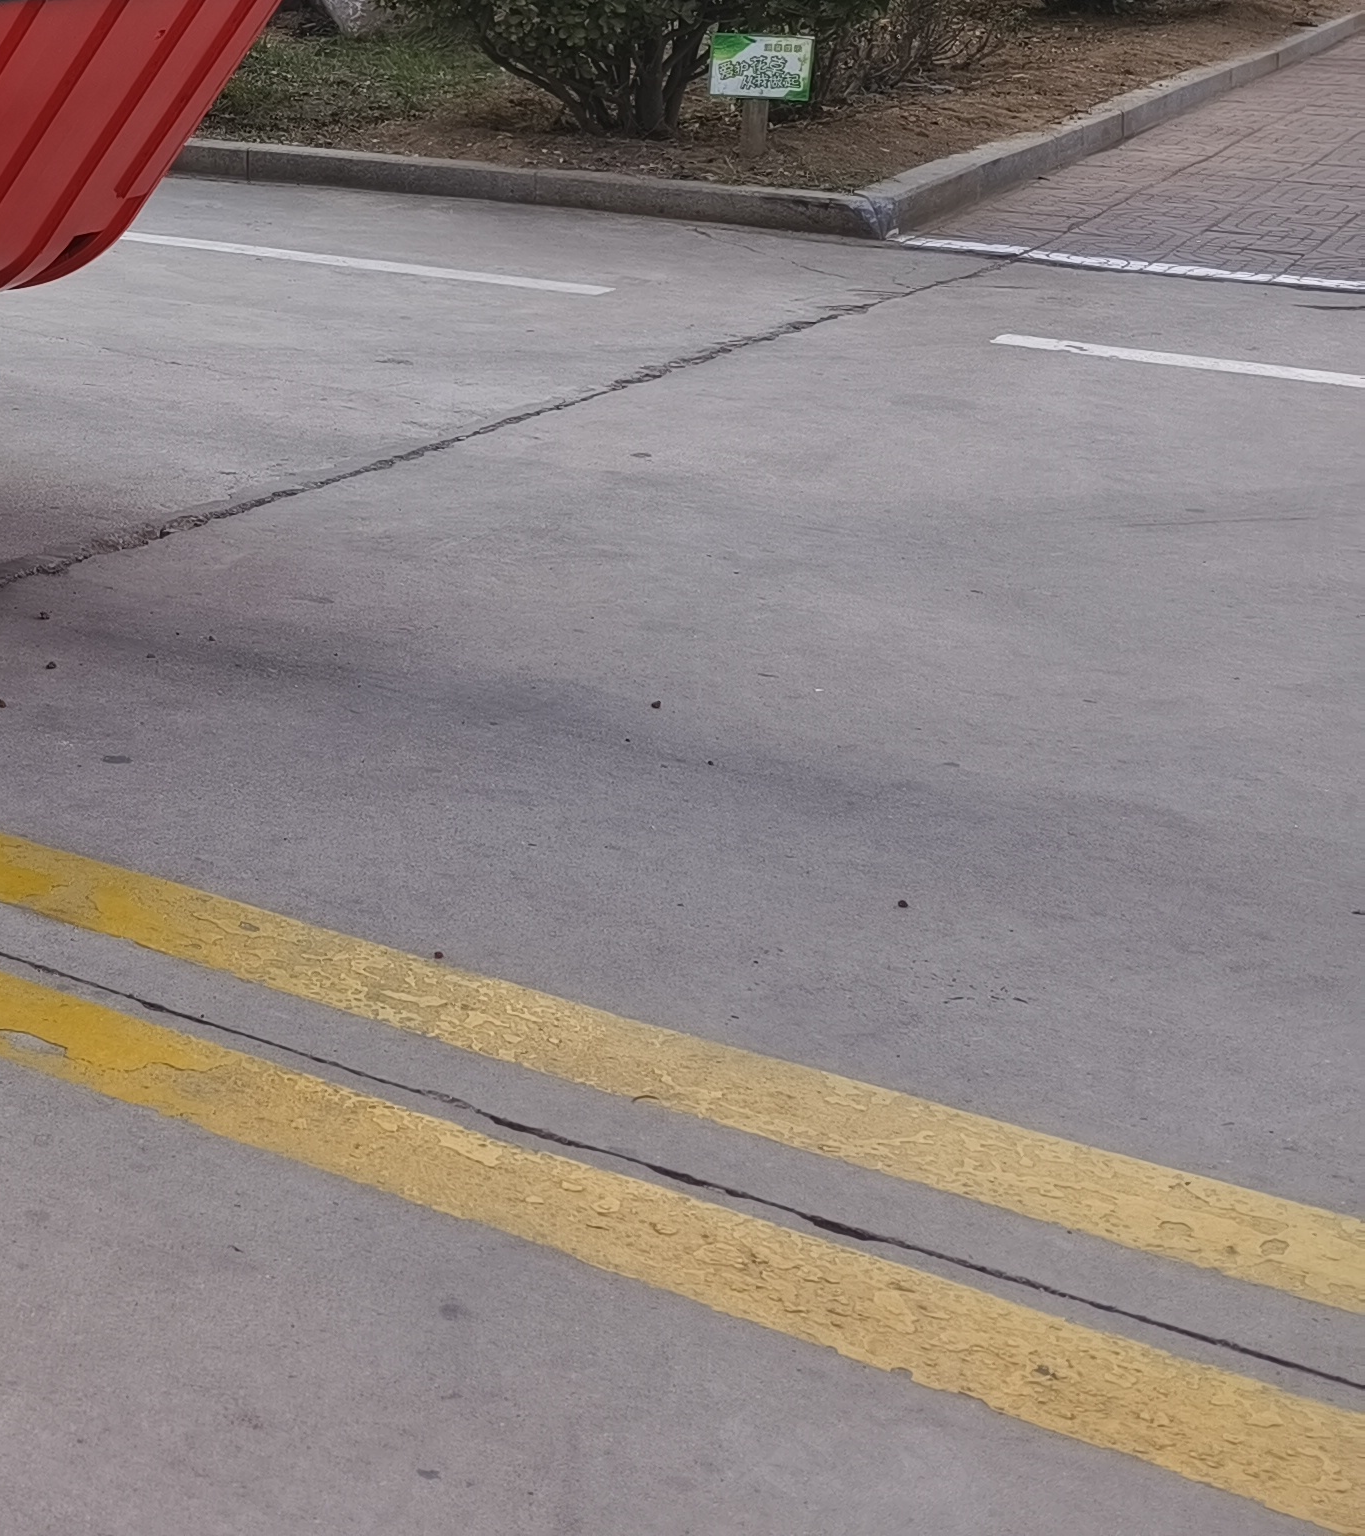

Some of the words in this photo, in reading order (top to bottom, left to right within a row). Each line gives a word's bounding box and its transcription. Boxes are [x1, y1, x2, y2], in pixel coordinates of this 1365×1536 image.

[717, 55, 788, 81] 爱护花草
[739, 71, 802, 91] 从我做起
